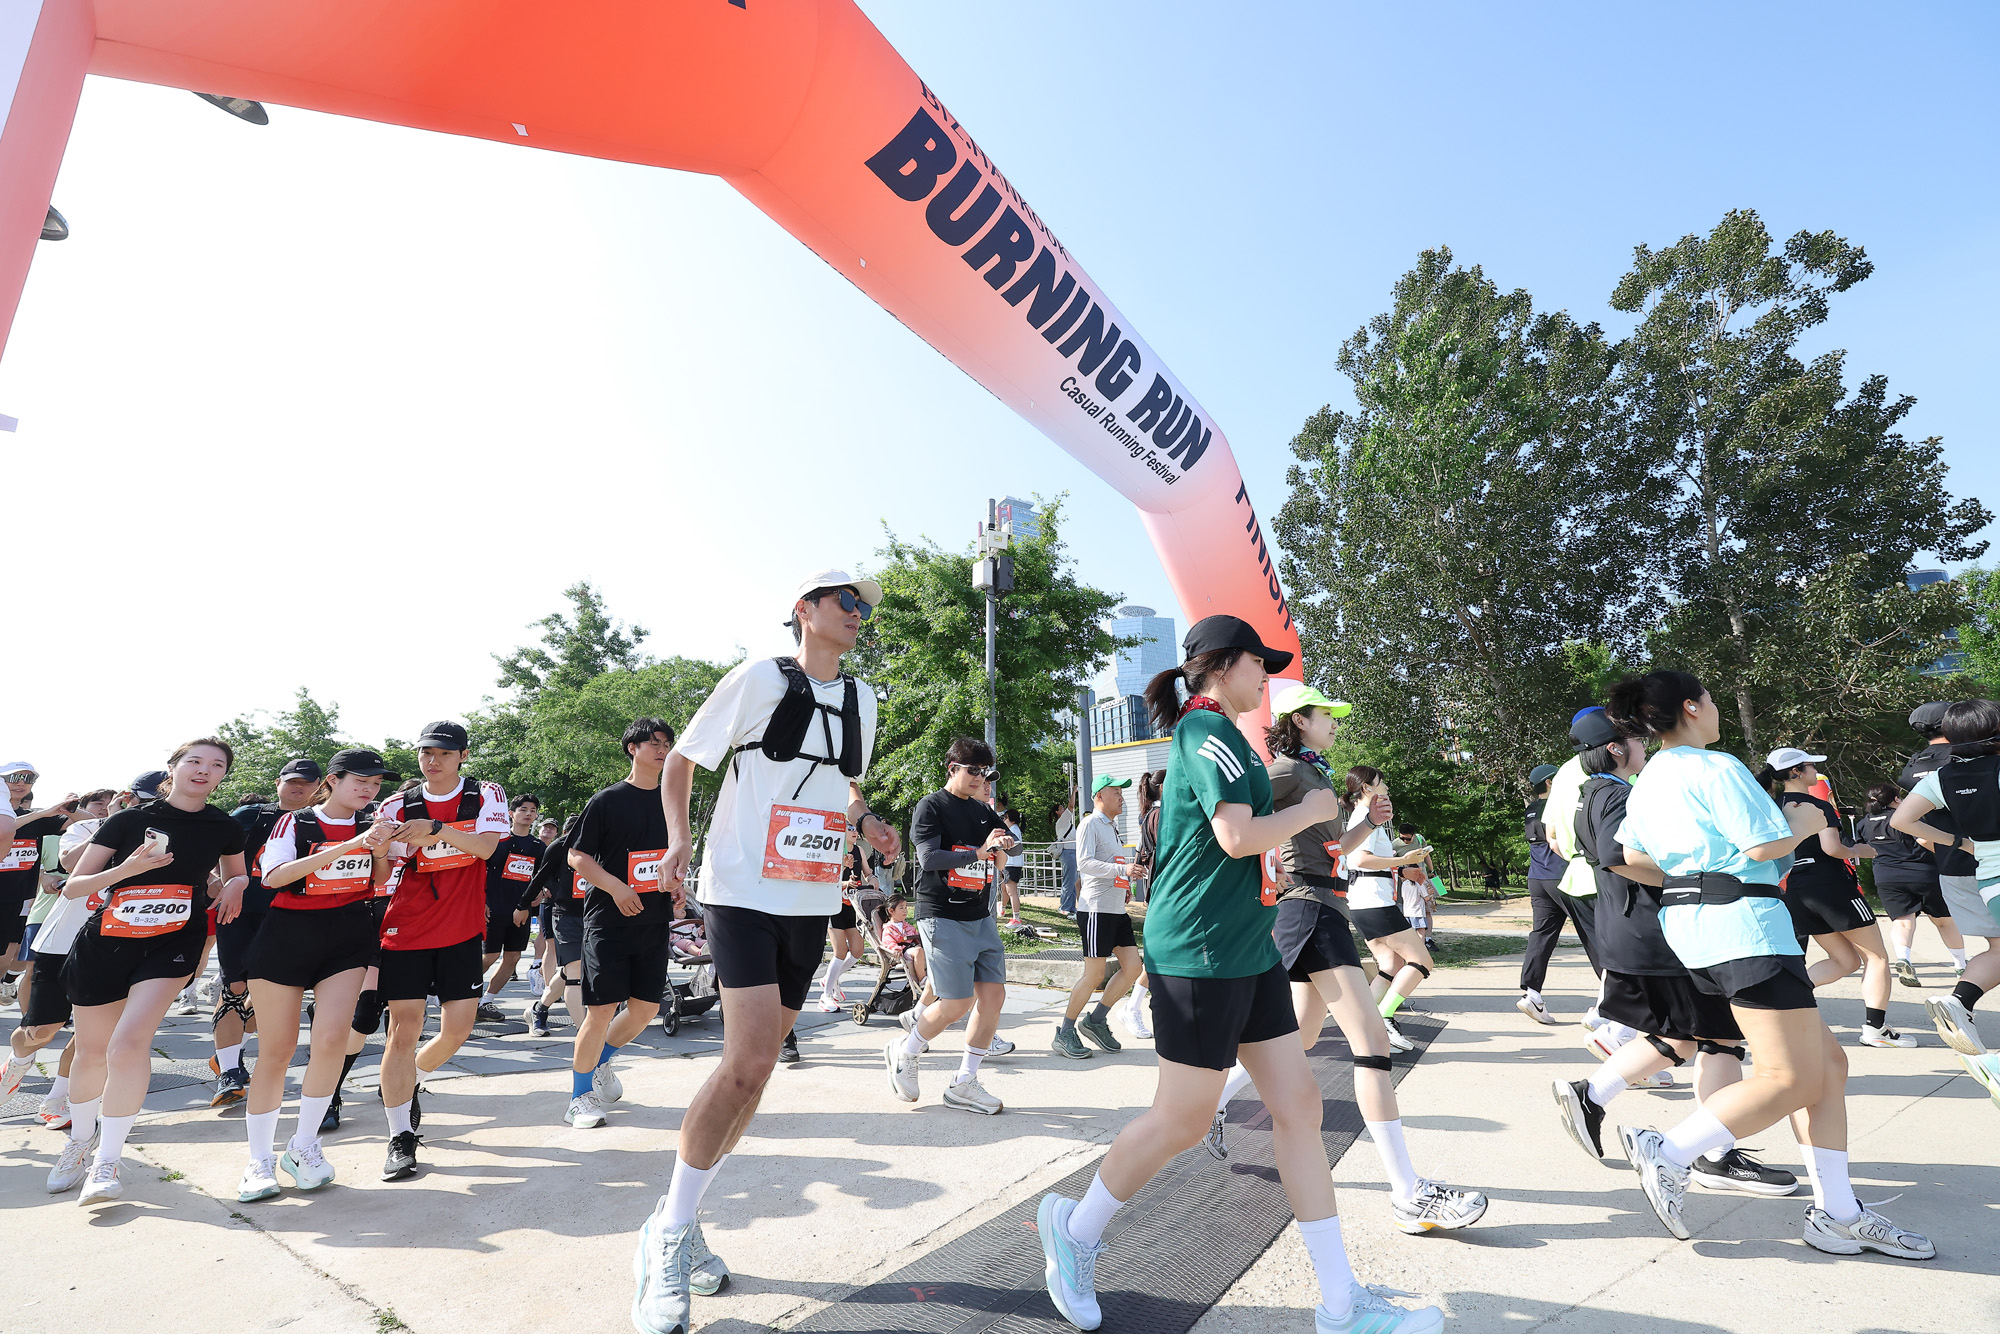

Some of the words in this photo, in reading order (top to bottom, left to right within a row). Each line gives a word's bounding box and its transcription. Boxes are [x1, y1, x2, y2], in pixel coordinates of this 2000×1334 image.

[864, 106, 1142, 402] BURNING
[1126, 372, 1212, 473] RUN
[1060, 375, 1104, 419] Casual
[1099, 411, 1145, 462] Running
[1140, 451, 1181, 486] Festival
[797, 816, 812, 825] C-7
[783, 834, 798, 847] M
[799, 833, 842, 852] 2501
[335, 858, 371, 871] 3614
[638, 867, 647, 875] M
[139, 903, 188, 915] 2800
[134, 916, 159, 924] B-322
